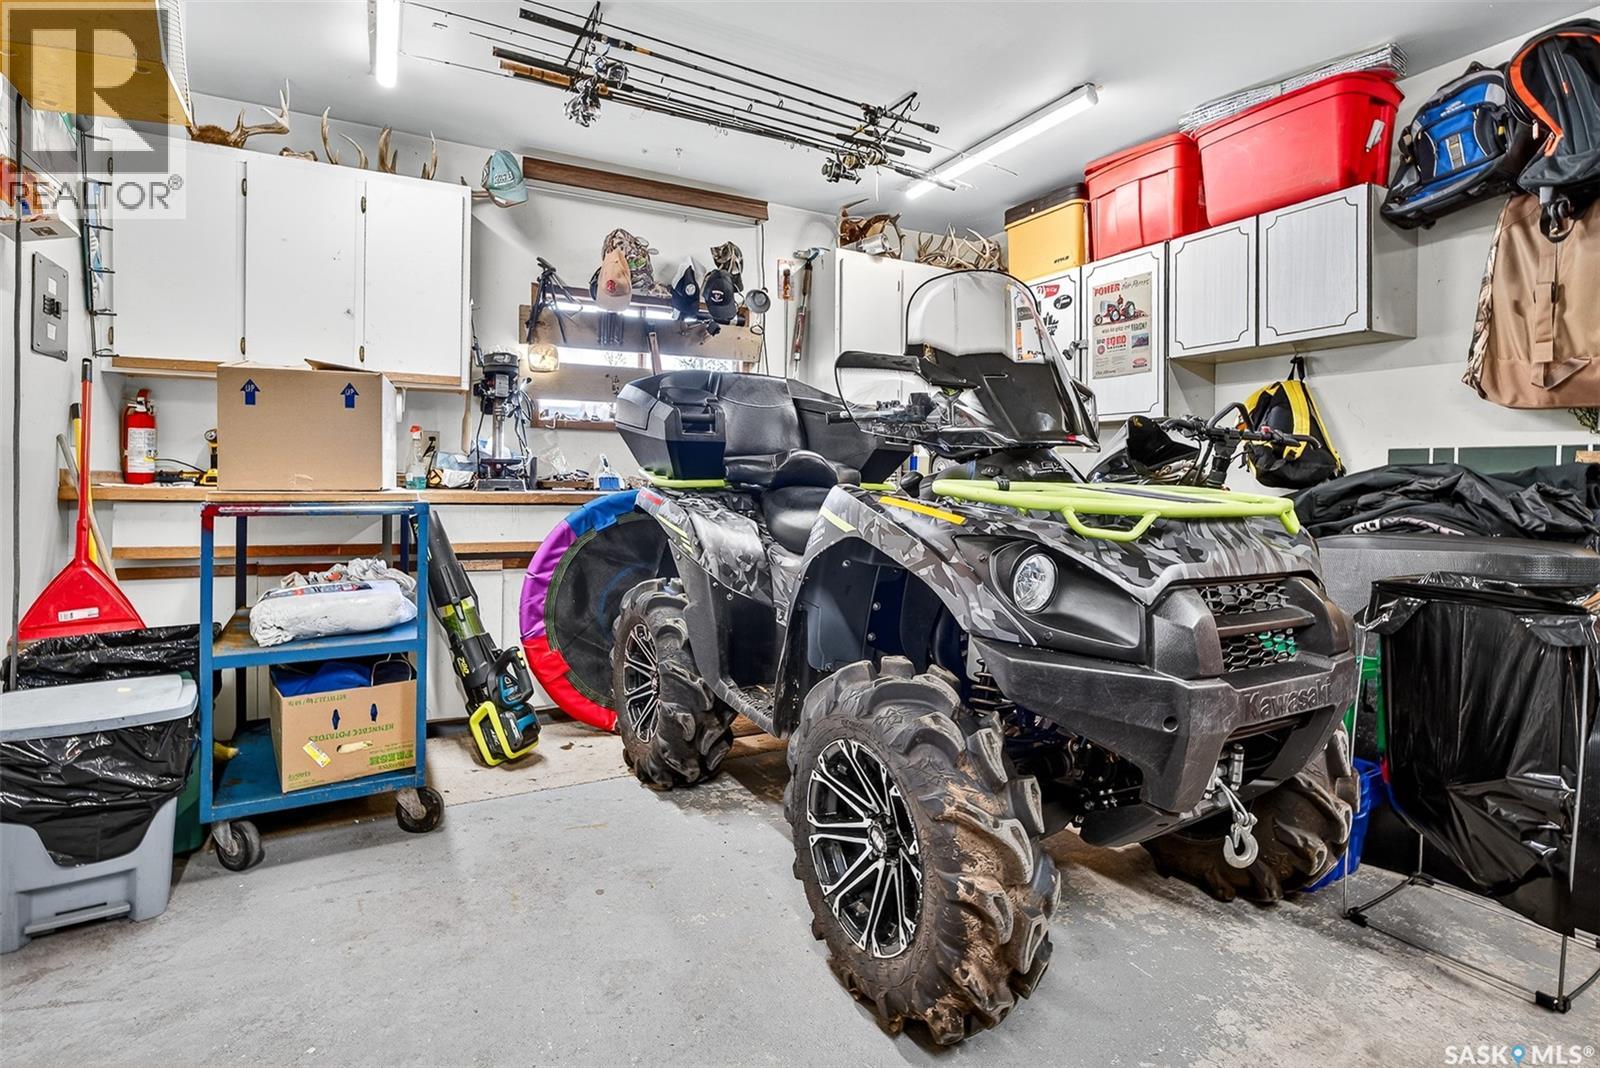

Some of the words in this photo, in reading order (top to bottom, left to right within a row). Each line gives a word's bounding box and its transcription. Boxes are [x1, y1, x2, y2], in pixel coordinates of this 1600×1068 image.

[1094, 283, 1121, 297] POWER
[244, 384, 256, 392] UP
[344, 388, 354, 396] UP
[1242, 677, 1332, 721] Kawasaki
